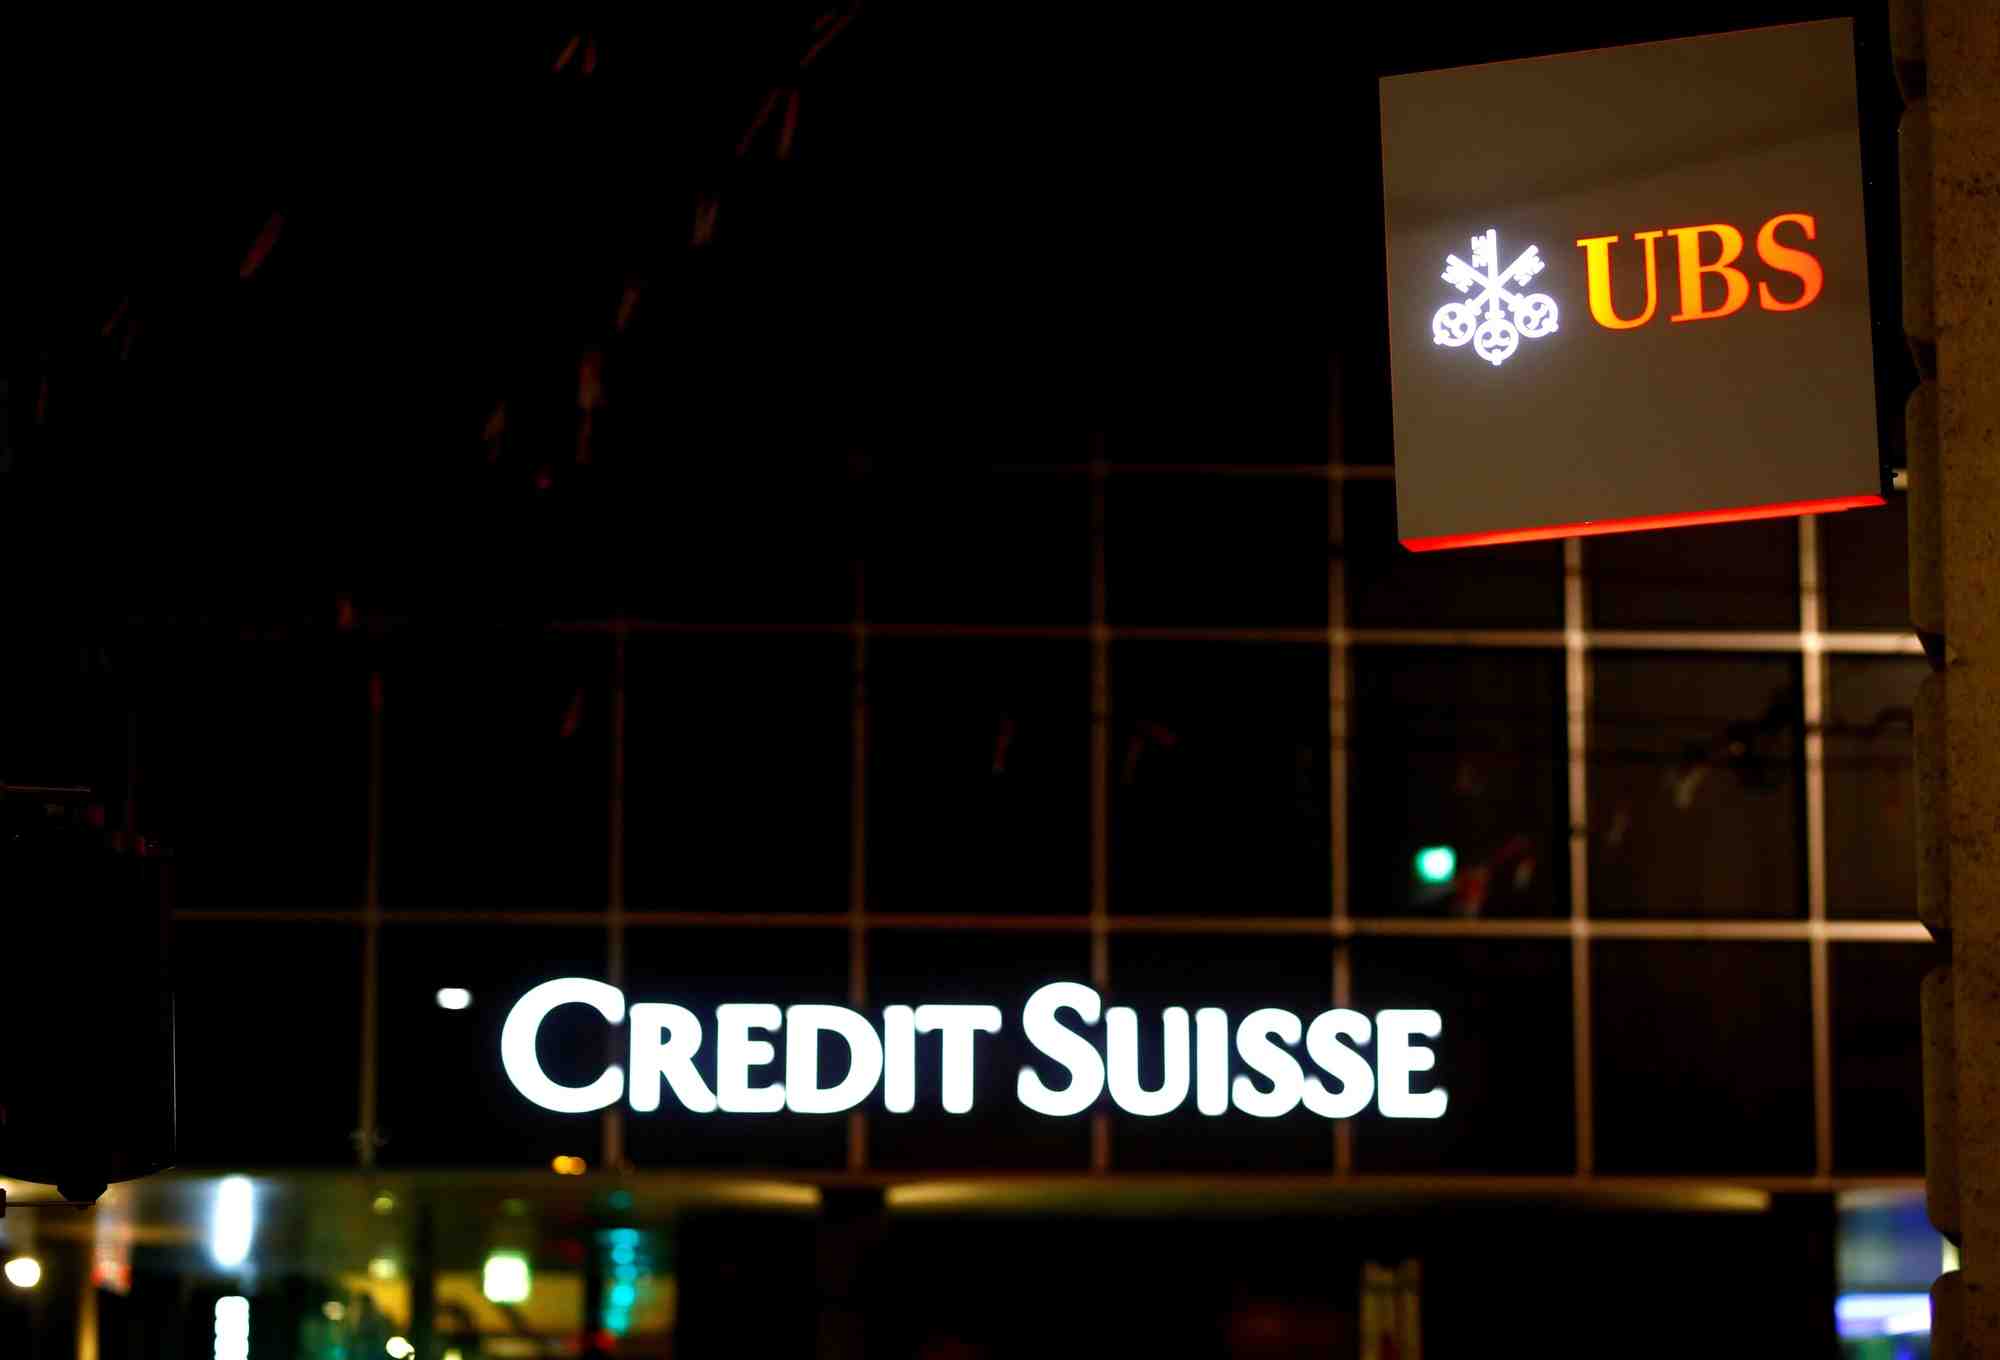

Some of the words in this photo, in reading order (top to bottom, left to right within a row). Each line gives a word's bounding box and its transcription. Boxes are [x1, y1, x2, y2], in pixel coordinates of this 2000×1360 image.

[1576, 213, 1824, 330] UBS
[501, 977, 1002, 1113] CREDIT
[1017, 981, 1448, 1118] SUISSE
